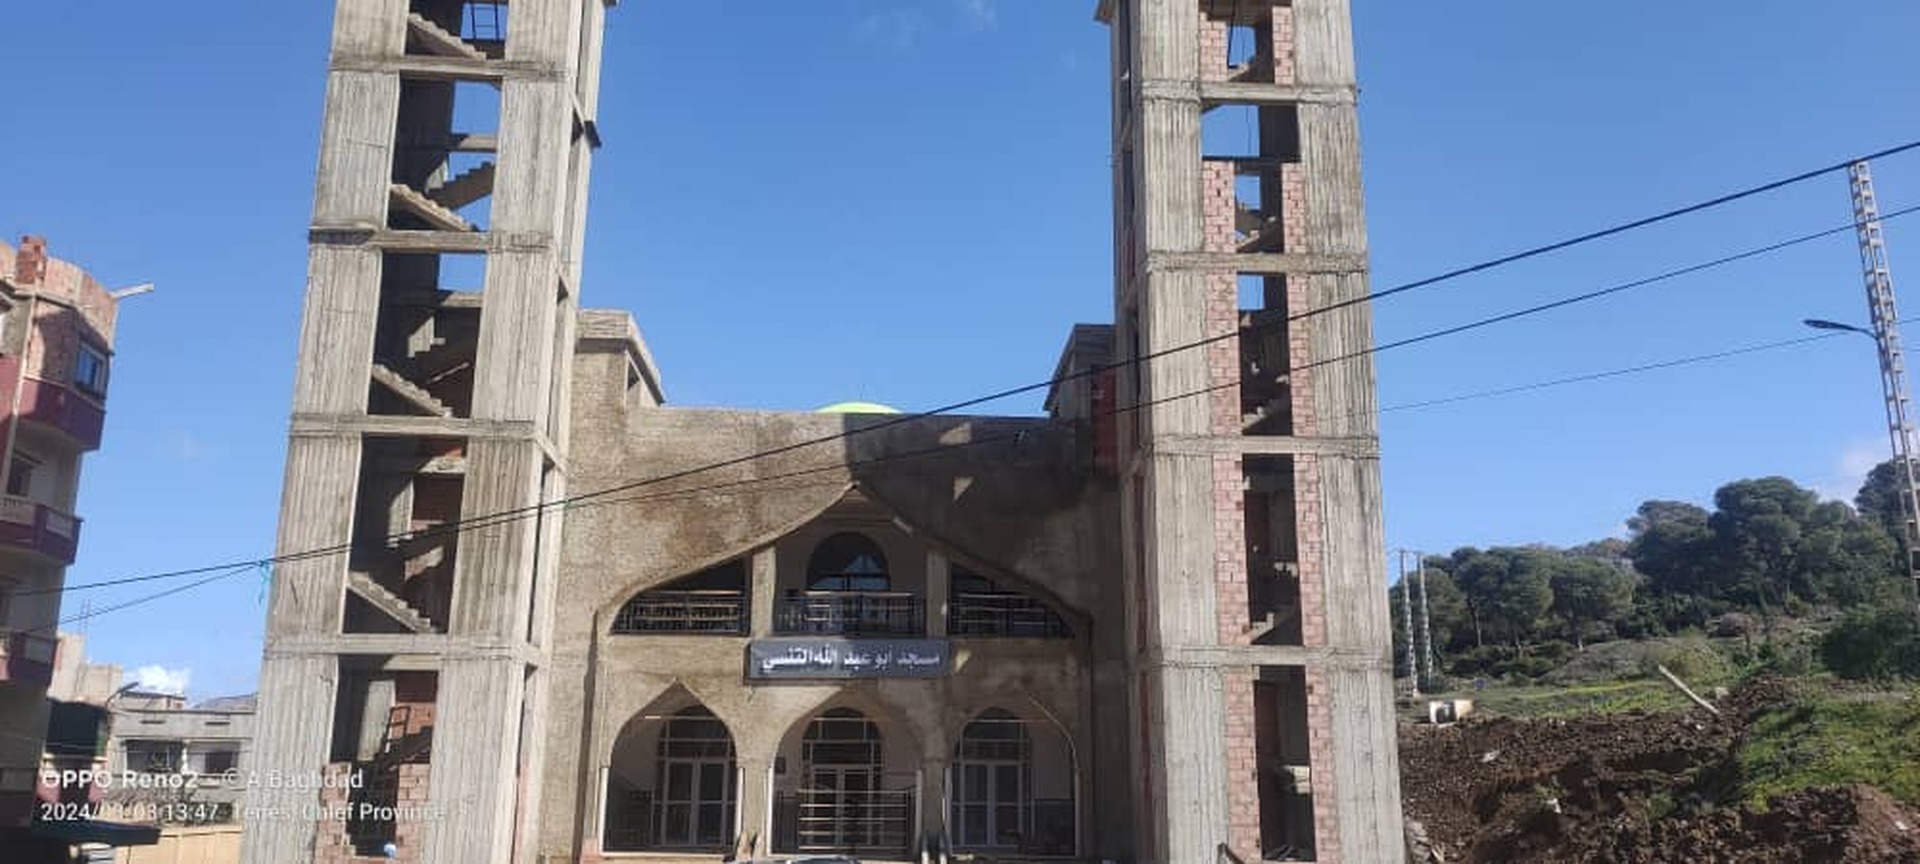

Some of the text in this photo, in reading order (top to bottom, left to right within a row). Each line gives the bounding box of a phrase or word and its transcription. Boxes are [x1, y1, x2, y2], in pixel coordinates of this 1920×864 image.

[763, 646, 813, 674] التنسي
[813, 643, 838, 664] الله
[843, 650, 872, 671] عبد
[897, 651, 940, 670] مسجد
